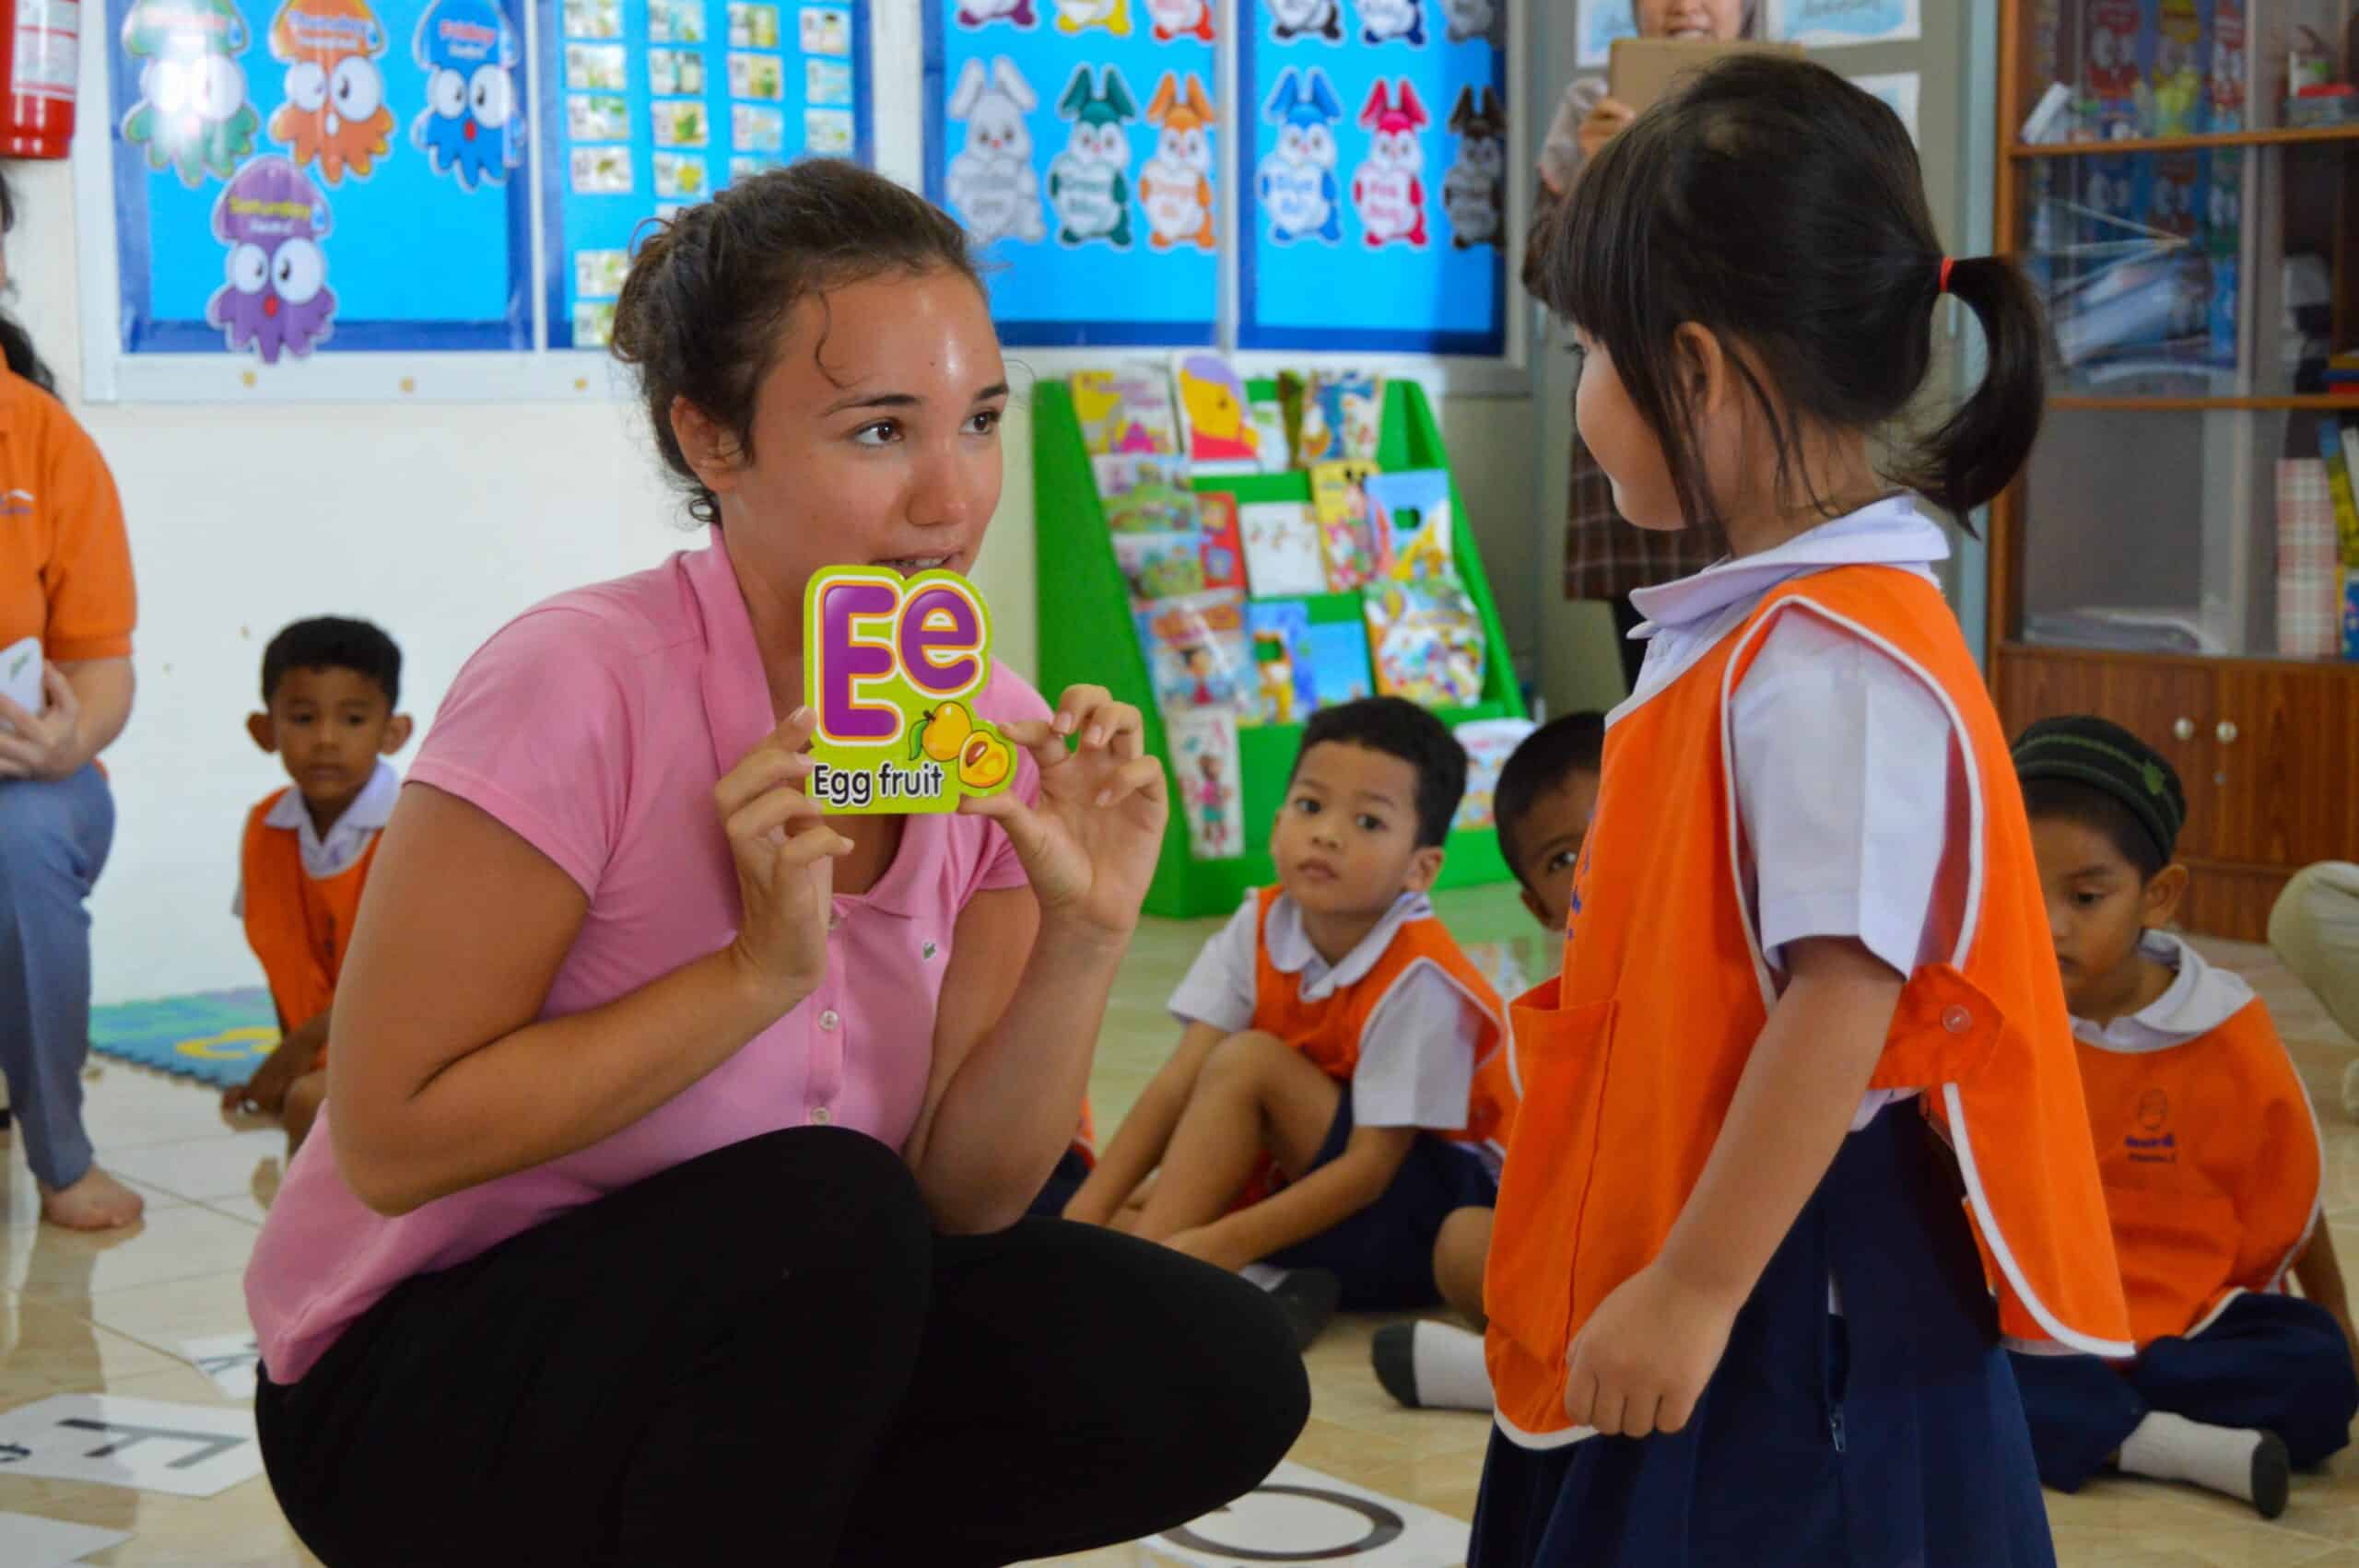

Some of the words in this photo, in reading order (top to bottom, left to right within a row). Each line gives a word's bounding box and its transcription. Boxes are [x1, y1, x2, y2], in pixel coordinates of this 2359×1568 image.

[816, 577, 986, 744] Ee
[814, 765, 871, 805] Egg
[878, 763, 944, 797] fruit
